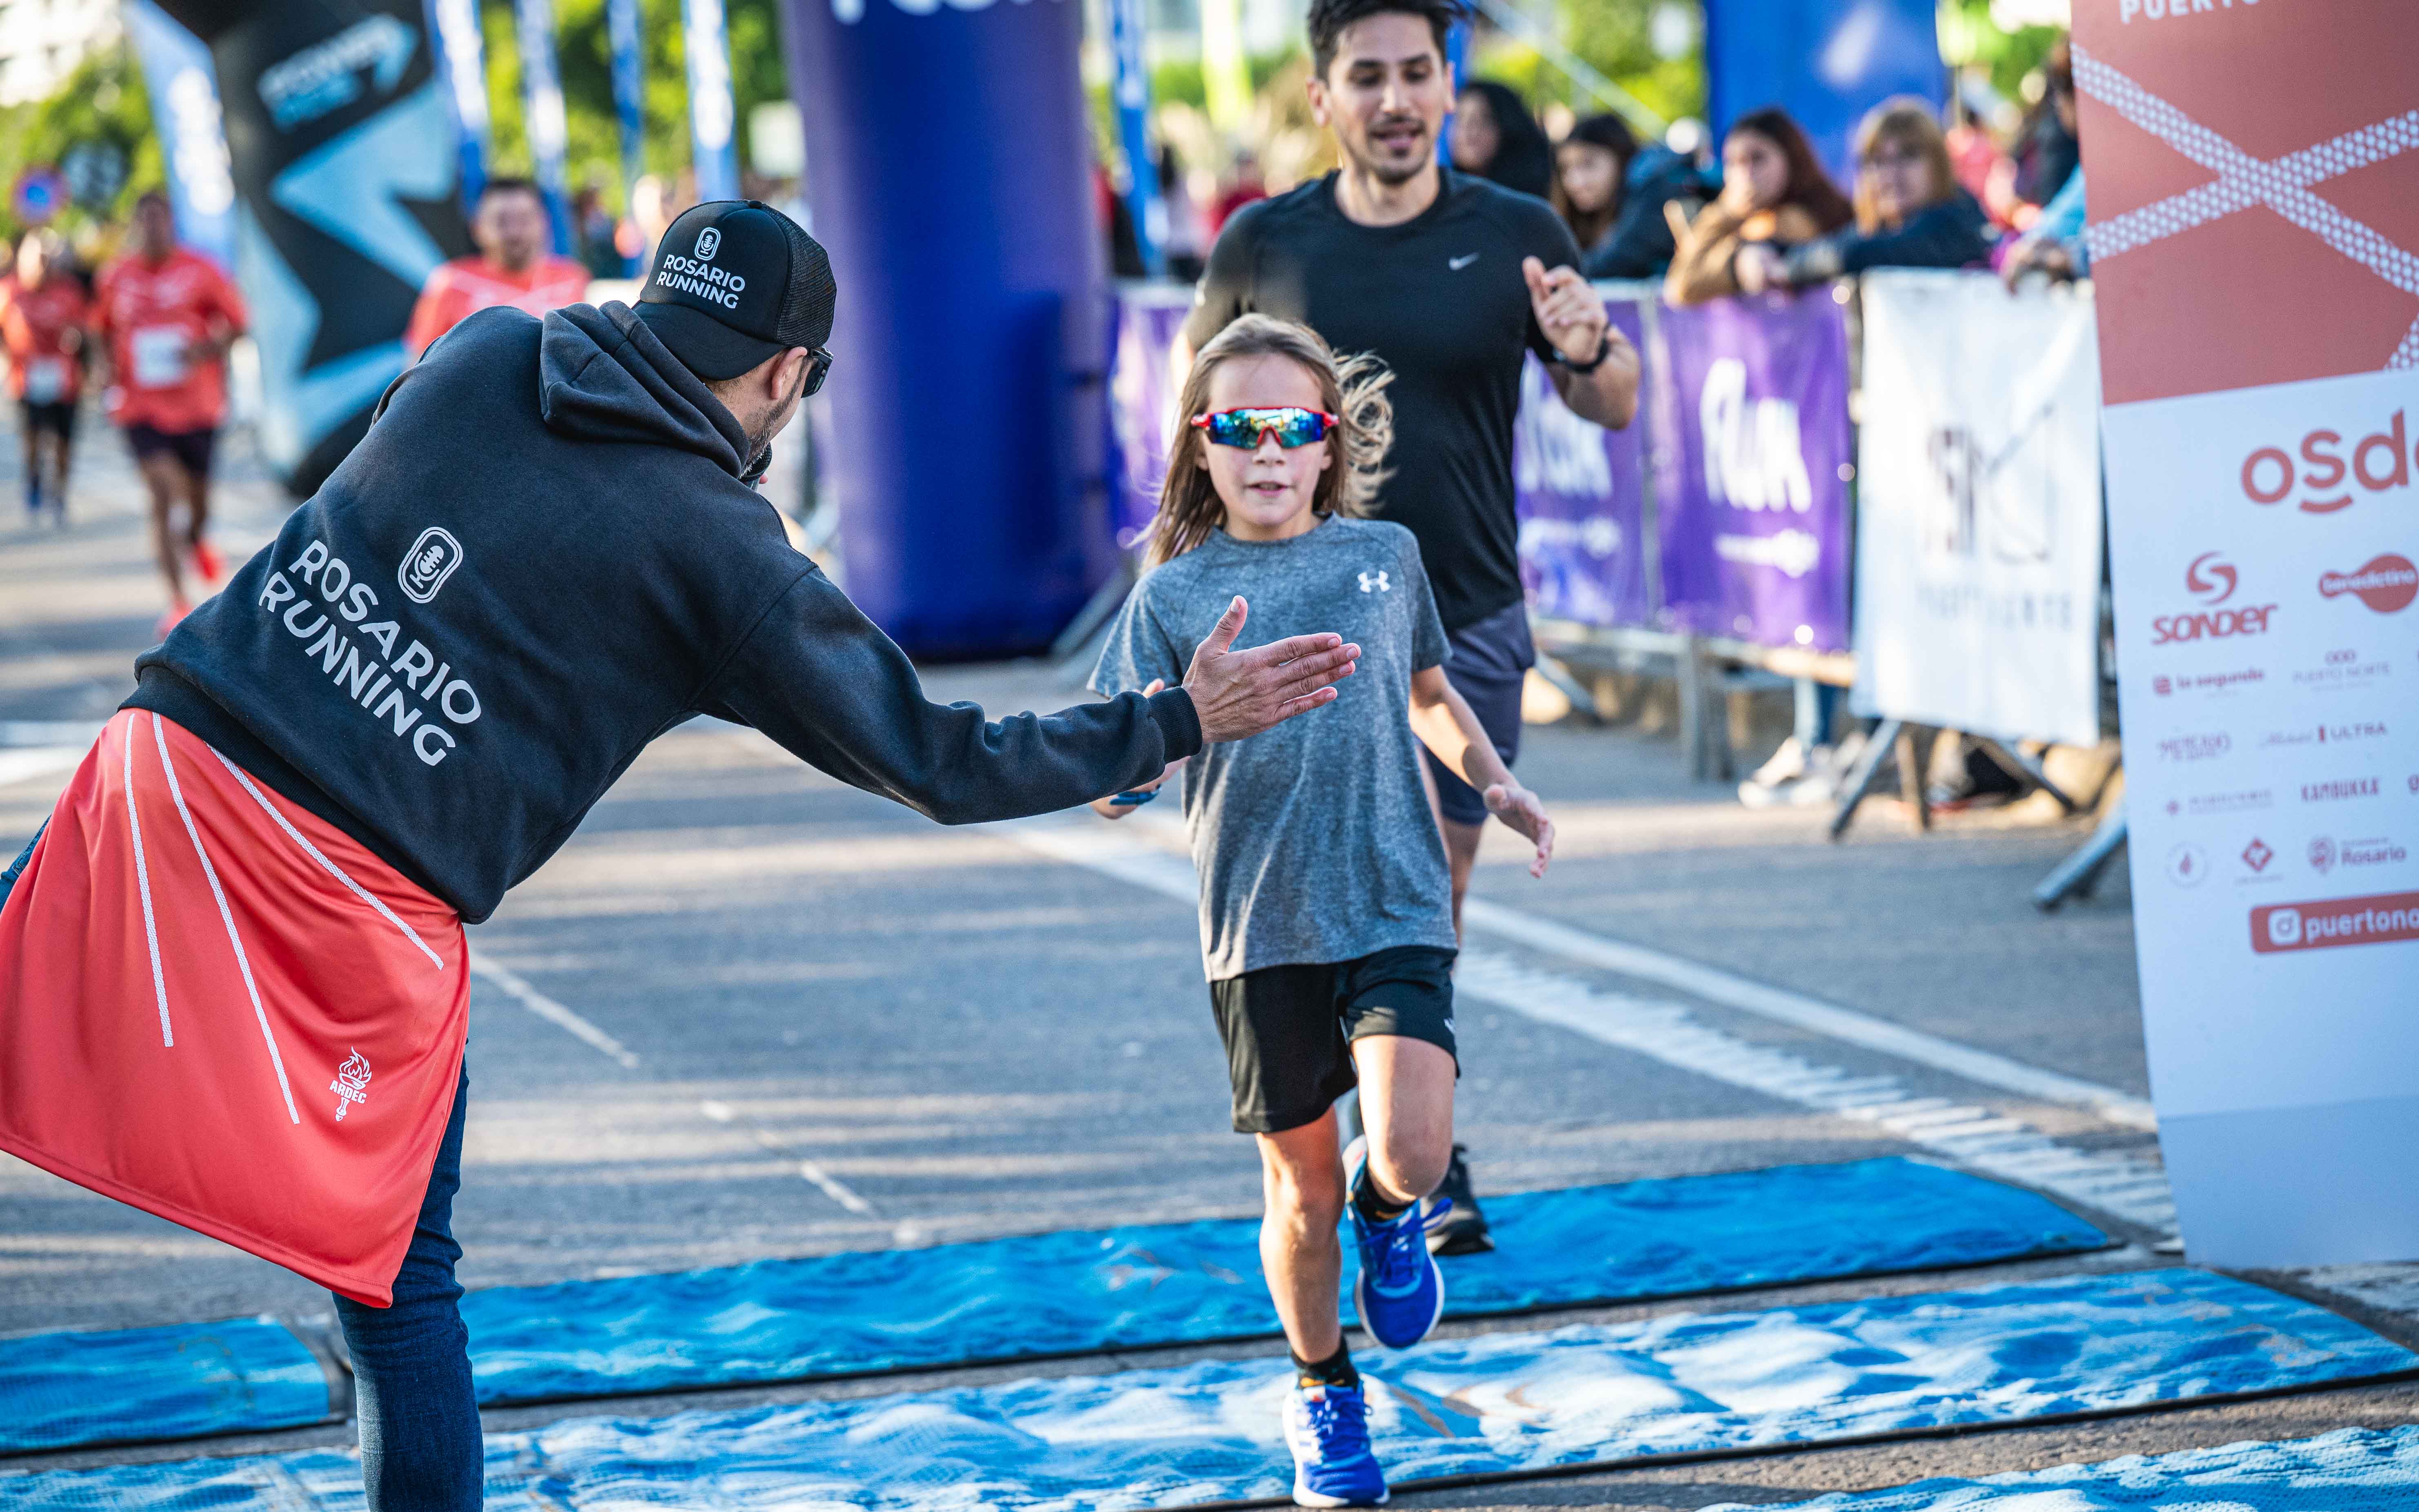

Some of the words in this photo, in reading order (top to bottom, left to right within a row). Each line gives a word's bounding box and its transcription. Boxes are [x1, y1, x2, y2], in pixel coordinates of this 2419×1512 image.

[2120, 0, 2259, 24] PUE
[656, 271, 739, 309] RUNNING
[664, 254, 746, 292] ROSARIO
[2241, 407, 2419, 506] osd
[288, 540, 482, 724] ROSARIO
[258, 571, 456, 766] RUNNING
[2331, 722, 2387, 740] ULTRA
[2341, 846, 2407, 865] Rosario
[329, 1080, 367, 1104] ARDEC
